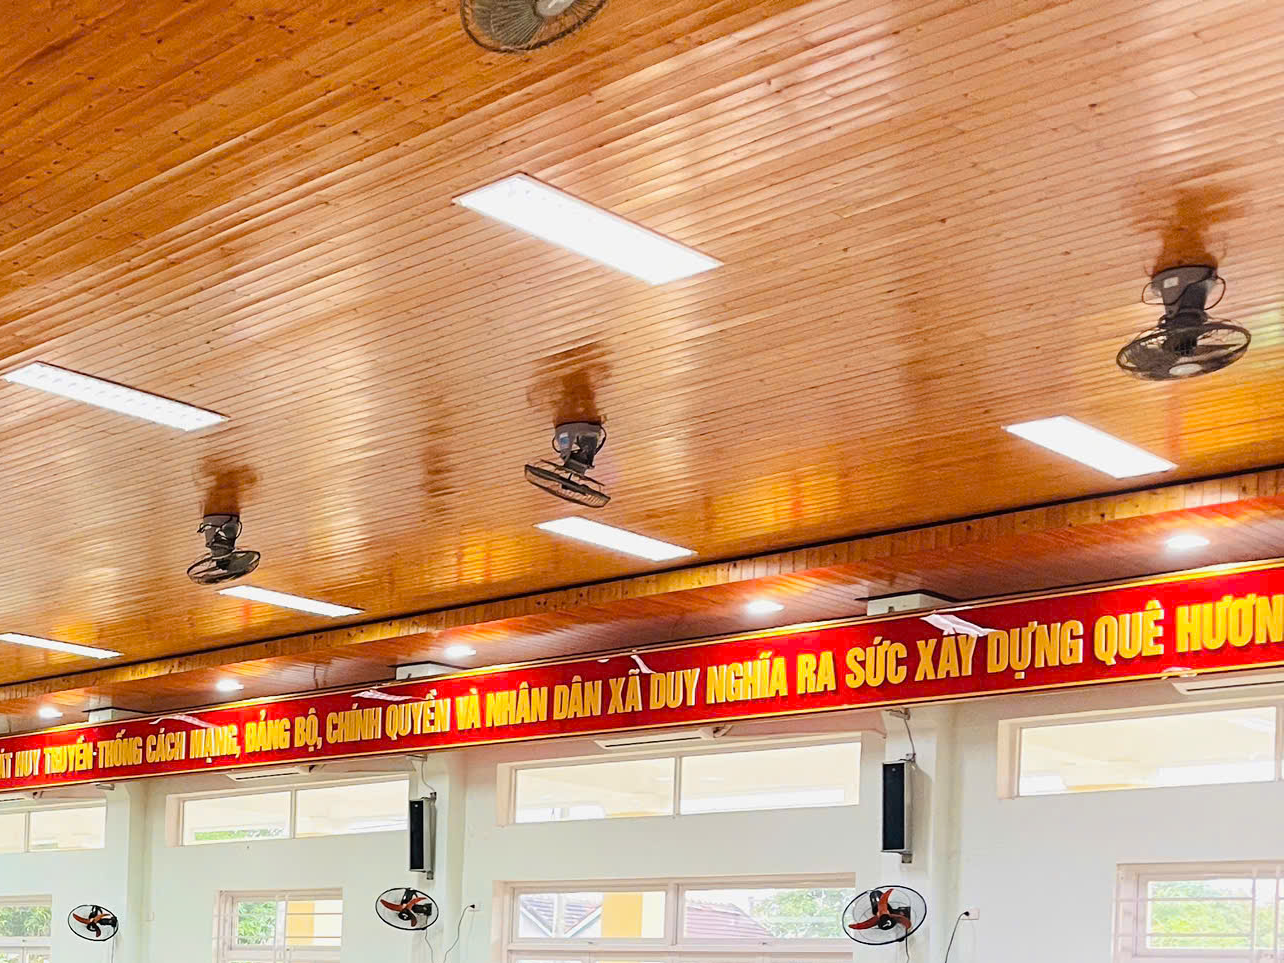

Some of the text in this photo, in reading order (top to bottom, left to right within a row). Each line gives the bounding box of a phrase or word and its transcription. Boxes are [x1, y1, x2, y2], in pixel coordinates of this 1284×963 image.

[15, 749, 41, 777] HUY
[43, 735, 93, 774] TRUYỀN
[97, 729, 143, 768] THỐNG
[146, 728, 186, 763] CÁCH
[190, 725, 240, 763] MẠNG,
[245, 710, 290, 753] ĐẢNG
[294, 707, 322, 752] BỘ,
[326, 703, 382, 744] CHÍNH
[385, 689, 451, 740] QUYỀN
[456, 688, 481, 730] VÀ
[486, 681, 547, 727] NHÂN
[553, 675, 602, 720] DÂN
[607, 668, 642, 715] XÃ
[649, 668, 700, 709] DUY
[706, 651, 788, 704] NGHĨA
[797, 651, 836, 694] RA
[845, 636, 907, 689] SỨC
[987, 619, 1083, 679] DỰNG
[1094, 599, 1164, 664] QUÊ
